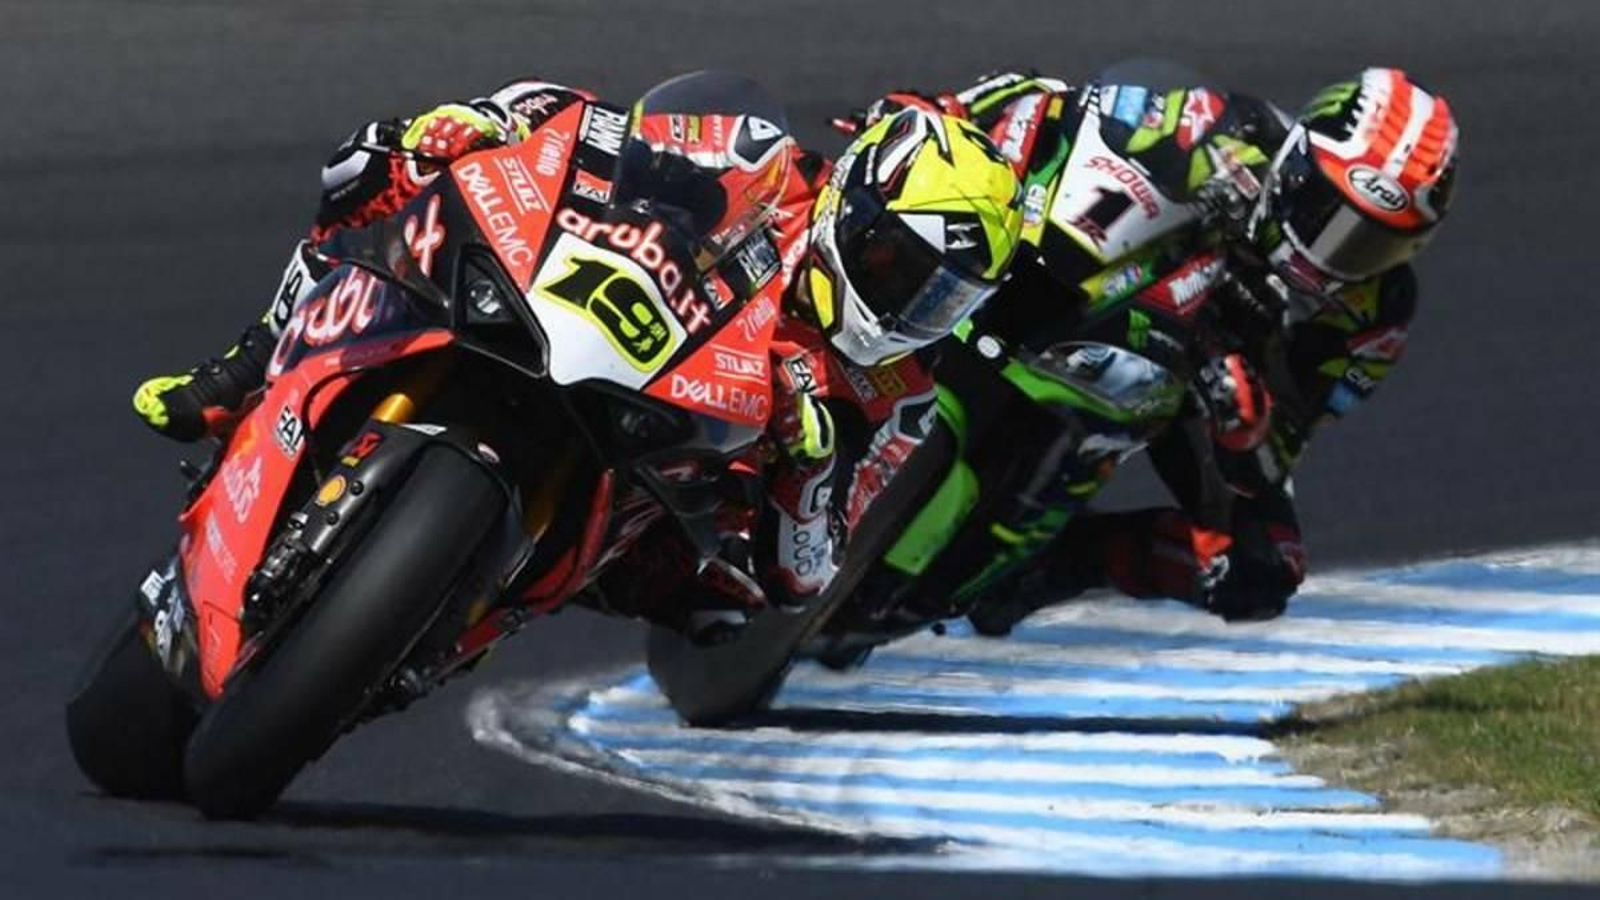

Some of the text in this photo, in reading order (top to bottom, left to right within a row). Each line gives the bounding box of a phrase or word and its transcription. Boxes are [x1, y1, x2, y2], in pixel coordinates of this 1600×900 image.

[1085, 185, 1135, 232] 1
[1349, 174, 1409, 207] Arai
[543, 255, 671, 364] 19
[556, 208, 712, 334] aruba.it
